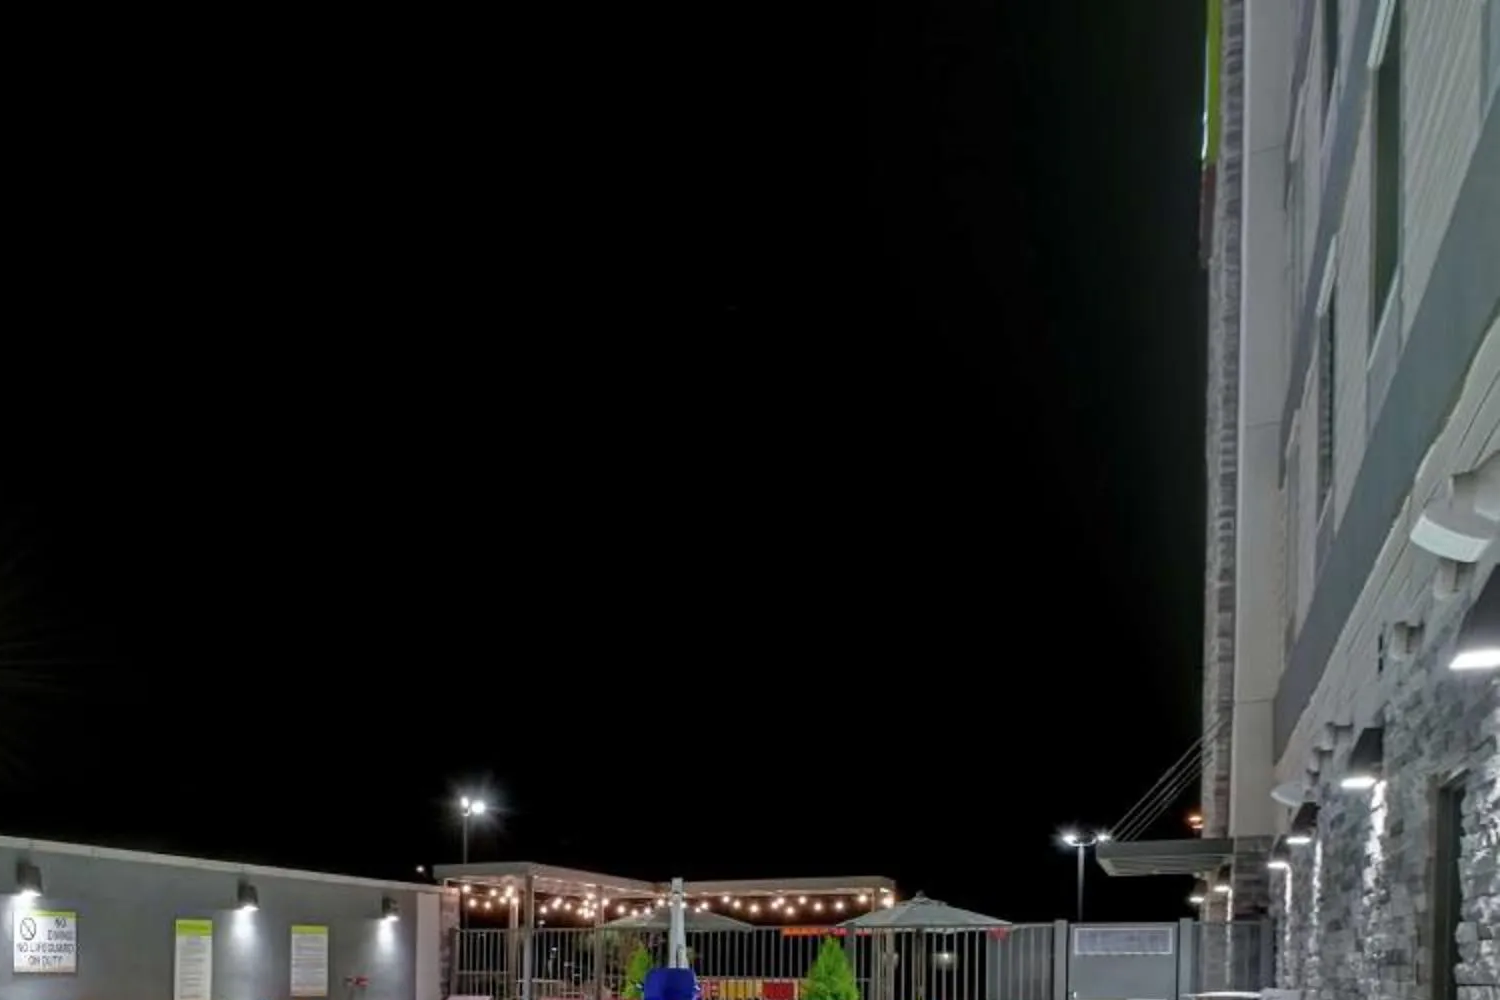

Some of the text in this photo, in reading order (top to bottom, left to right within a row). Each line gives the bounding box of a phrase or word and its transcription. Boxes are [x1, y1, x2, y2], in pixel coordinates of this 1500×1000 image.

[54, 917, 68, 929] NO
[16, 942, 30, 953] NO
[27, 955, 63, 966] ON DUTY
